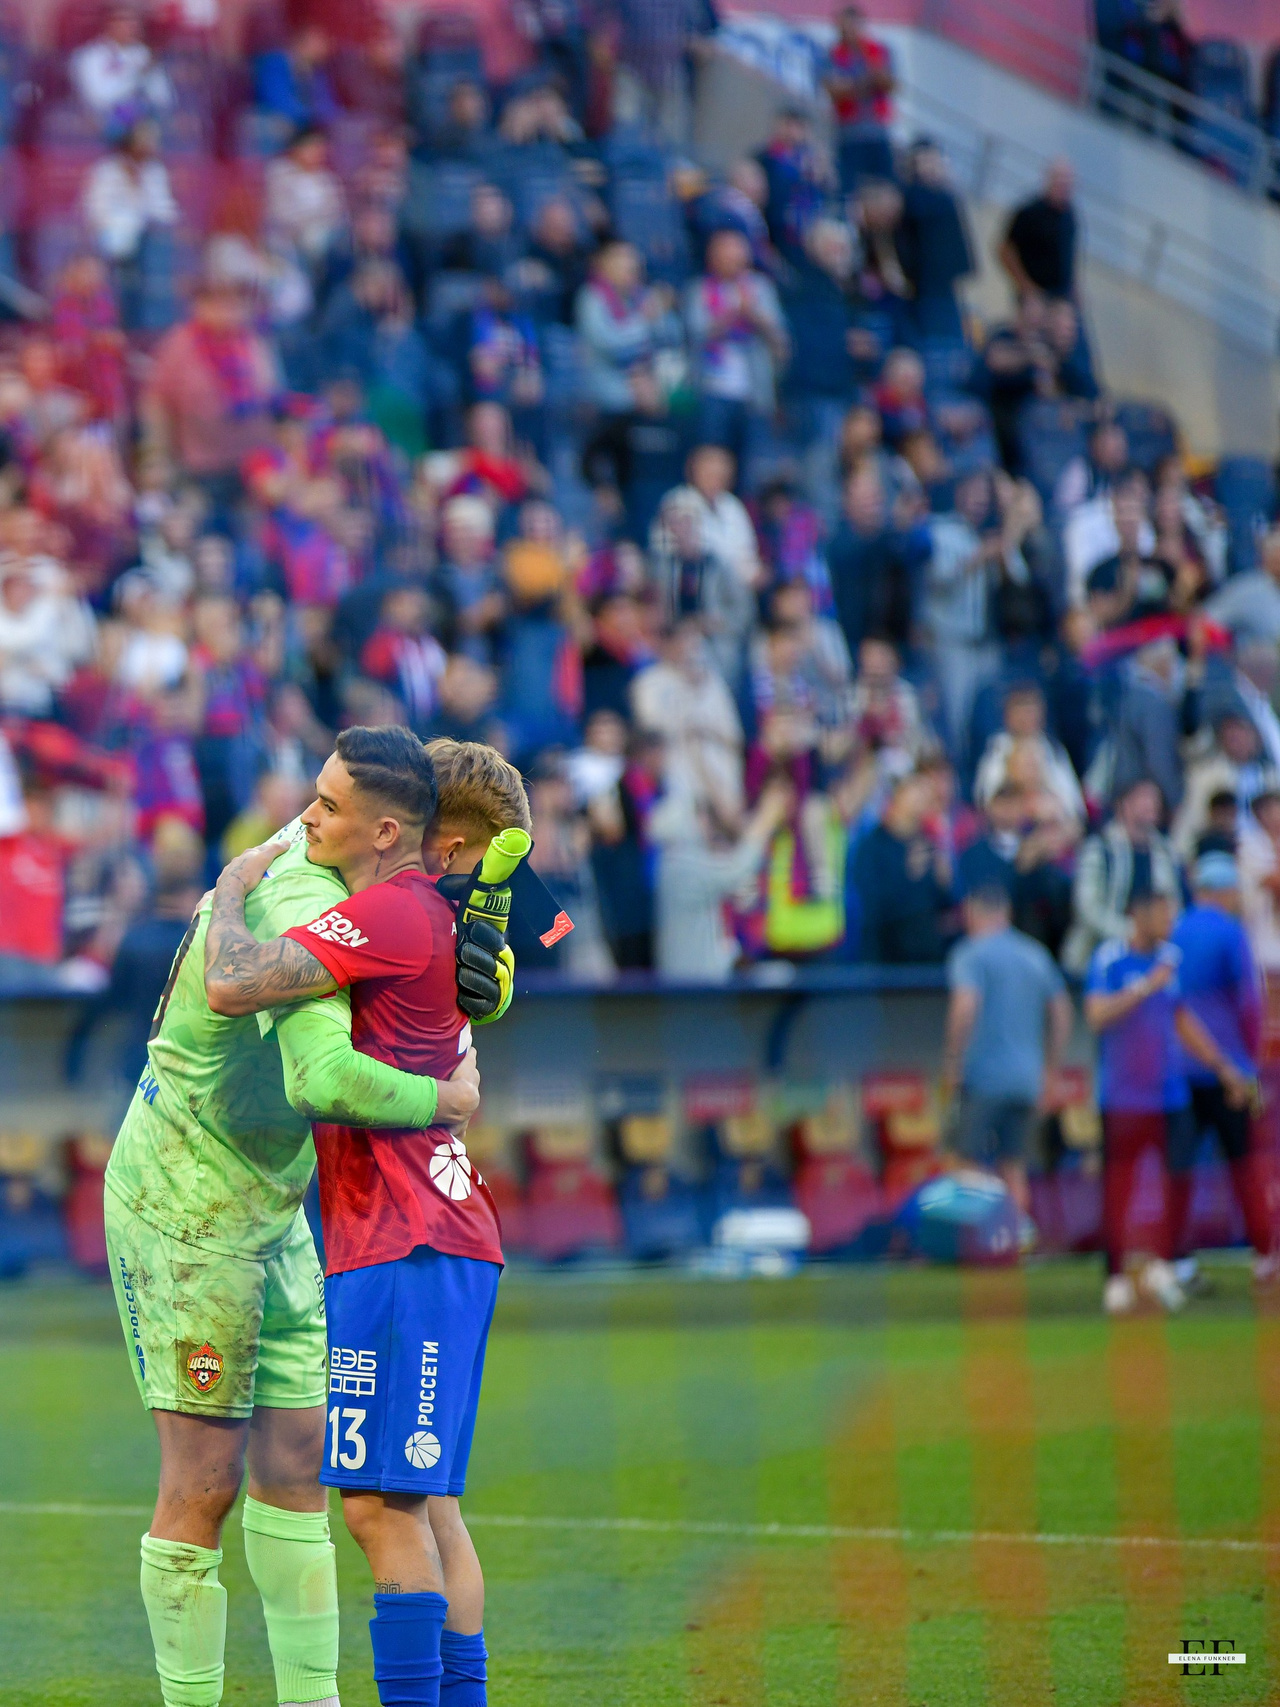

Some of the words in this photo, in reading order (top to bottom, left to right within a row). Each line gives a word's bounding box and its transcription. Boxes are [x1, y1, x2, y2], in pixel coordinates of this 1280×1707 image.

[320, 910, 370, 948] FON
[119, 1256, 140, 1338] РОССЕТИ
[190, 1356, 220, 1371] ЦСКА
[330, 1346, 377, 1371] ВЭБ
[417, 1341, 439, 1426] РОССЕТИ
[329, 1406, 366, 1470] 13
